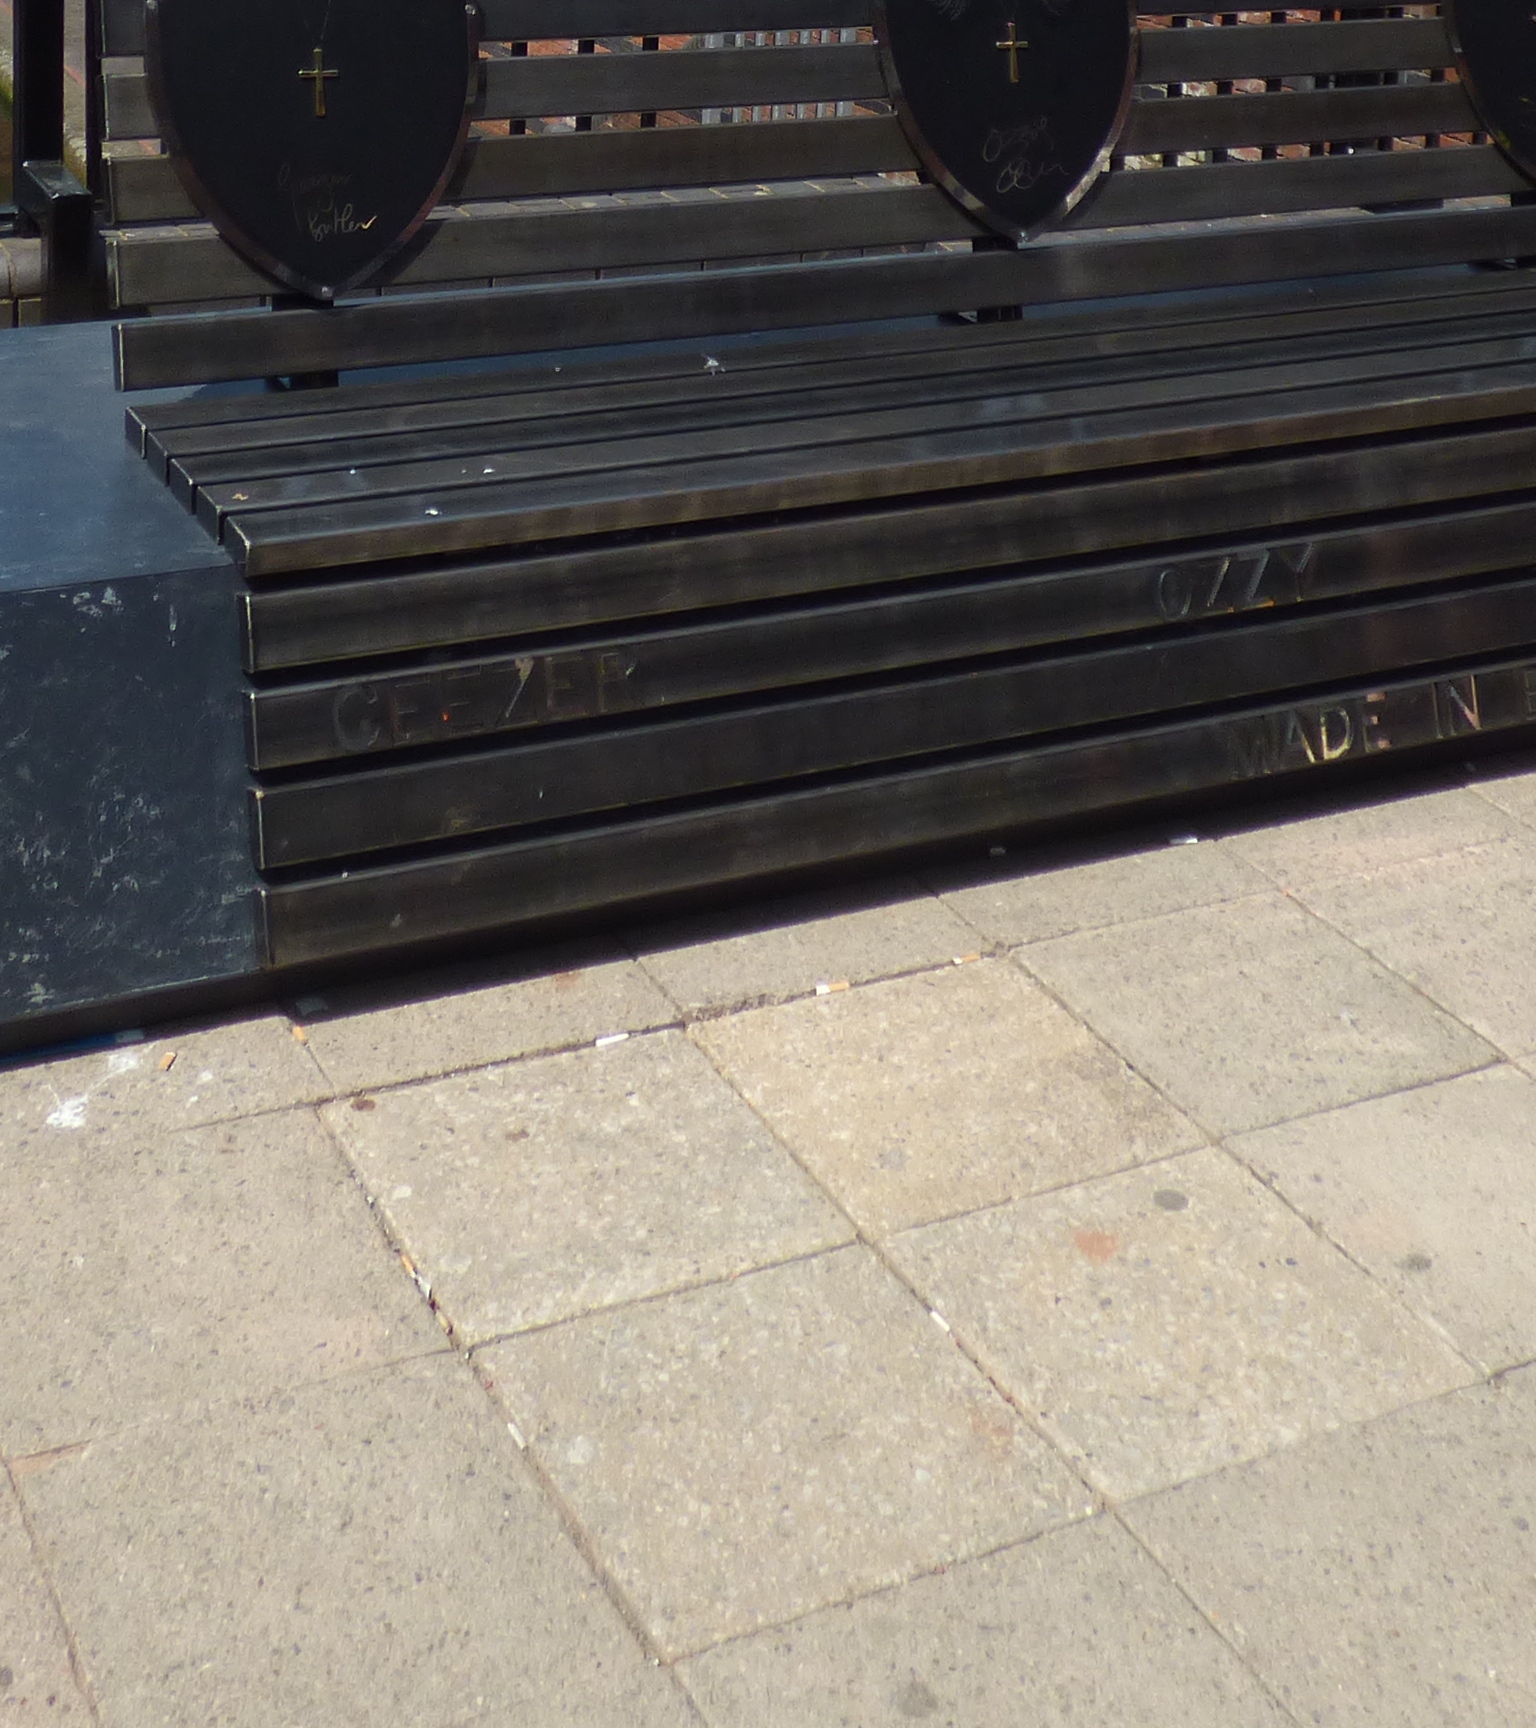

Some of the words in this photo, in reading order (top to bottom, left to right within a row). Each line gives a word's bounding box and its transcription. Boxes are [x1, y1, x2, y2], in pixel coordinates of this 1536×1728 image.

[1158, 541, 1316, 622] OZZY
[1228, 691, 1391, 782] MADE
[1431, 673, 1484, 740] IN
